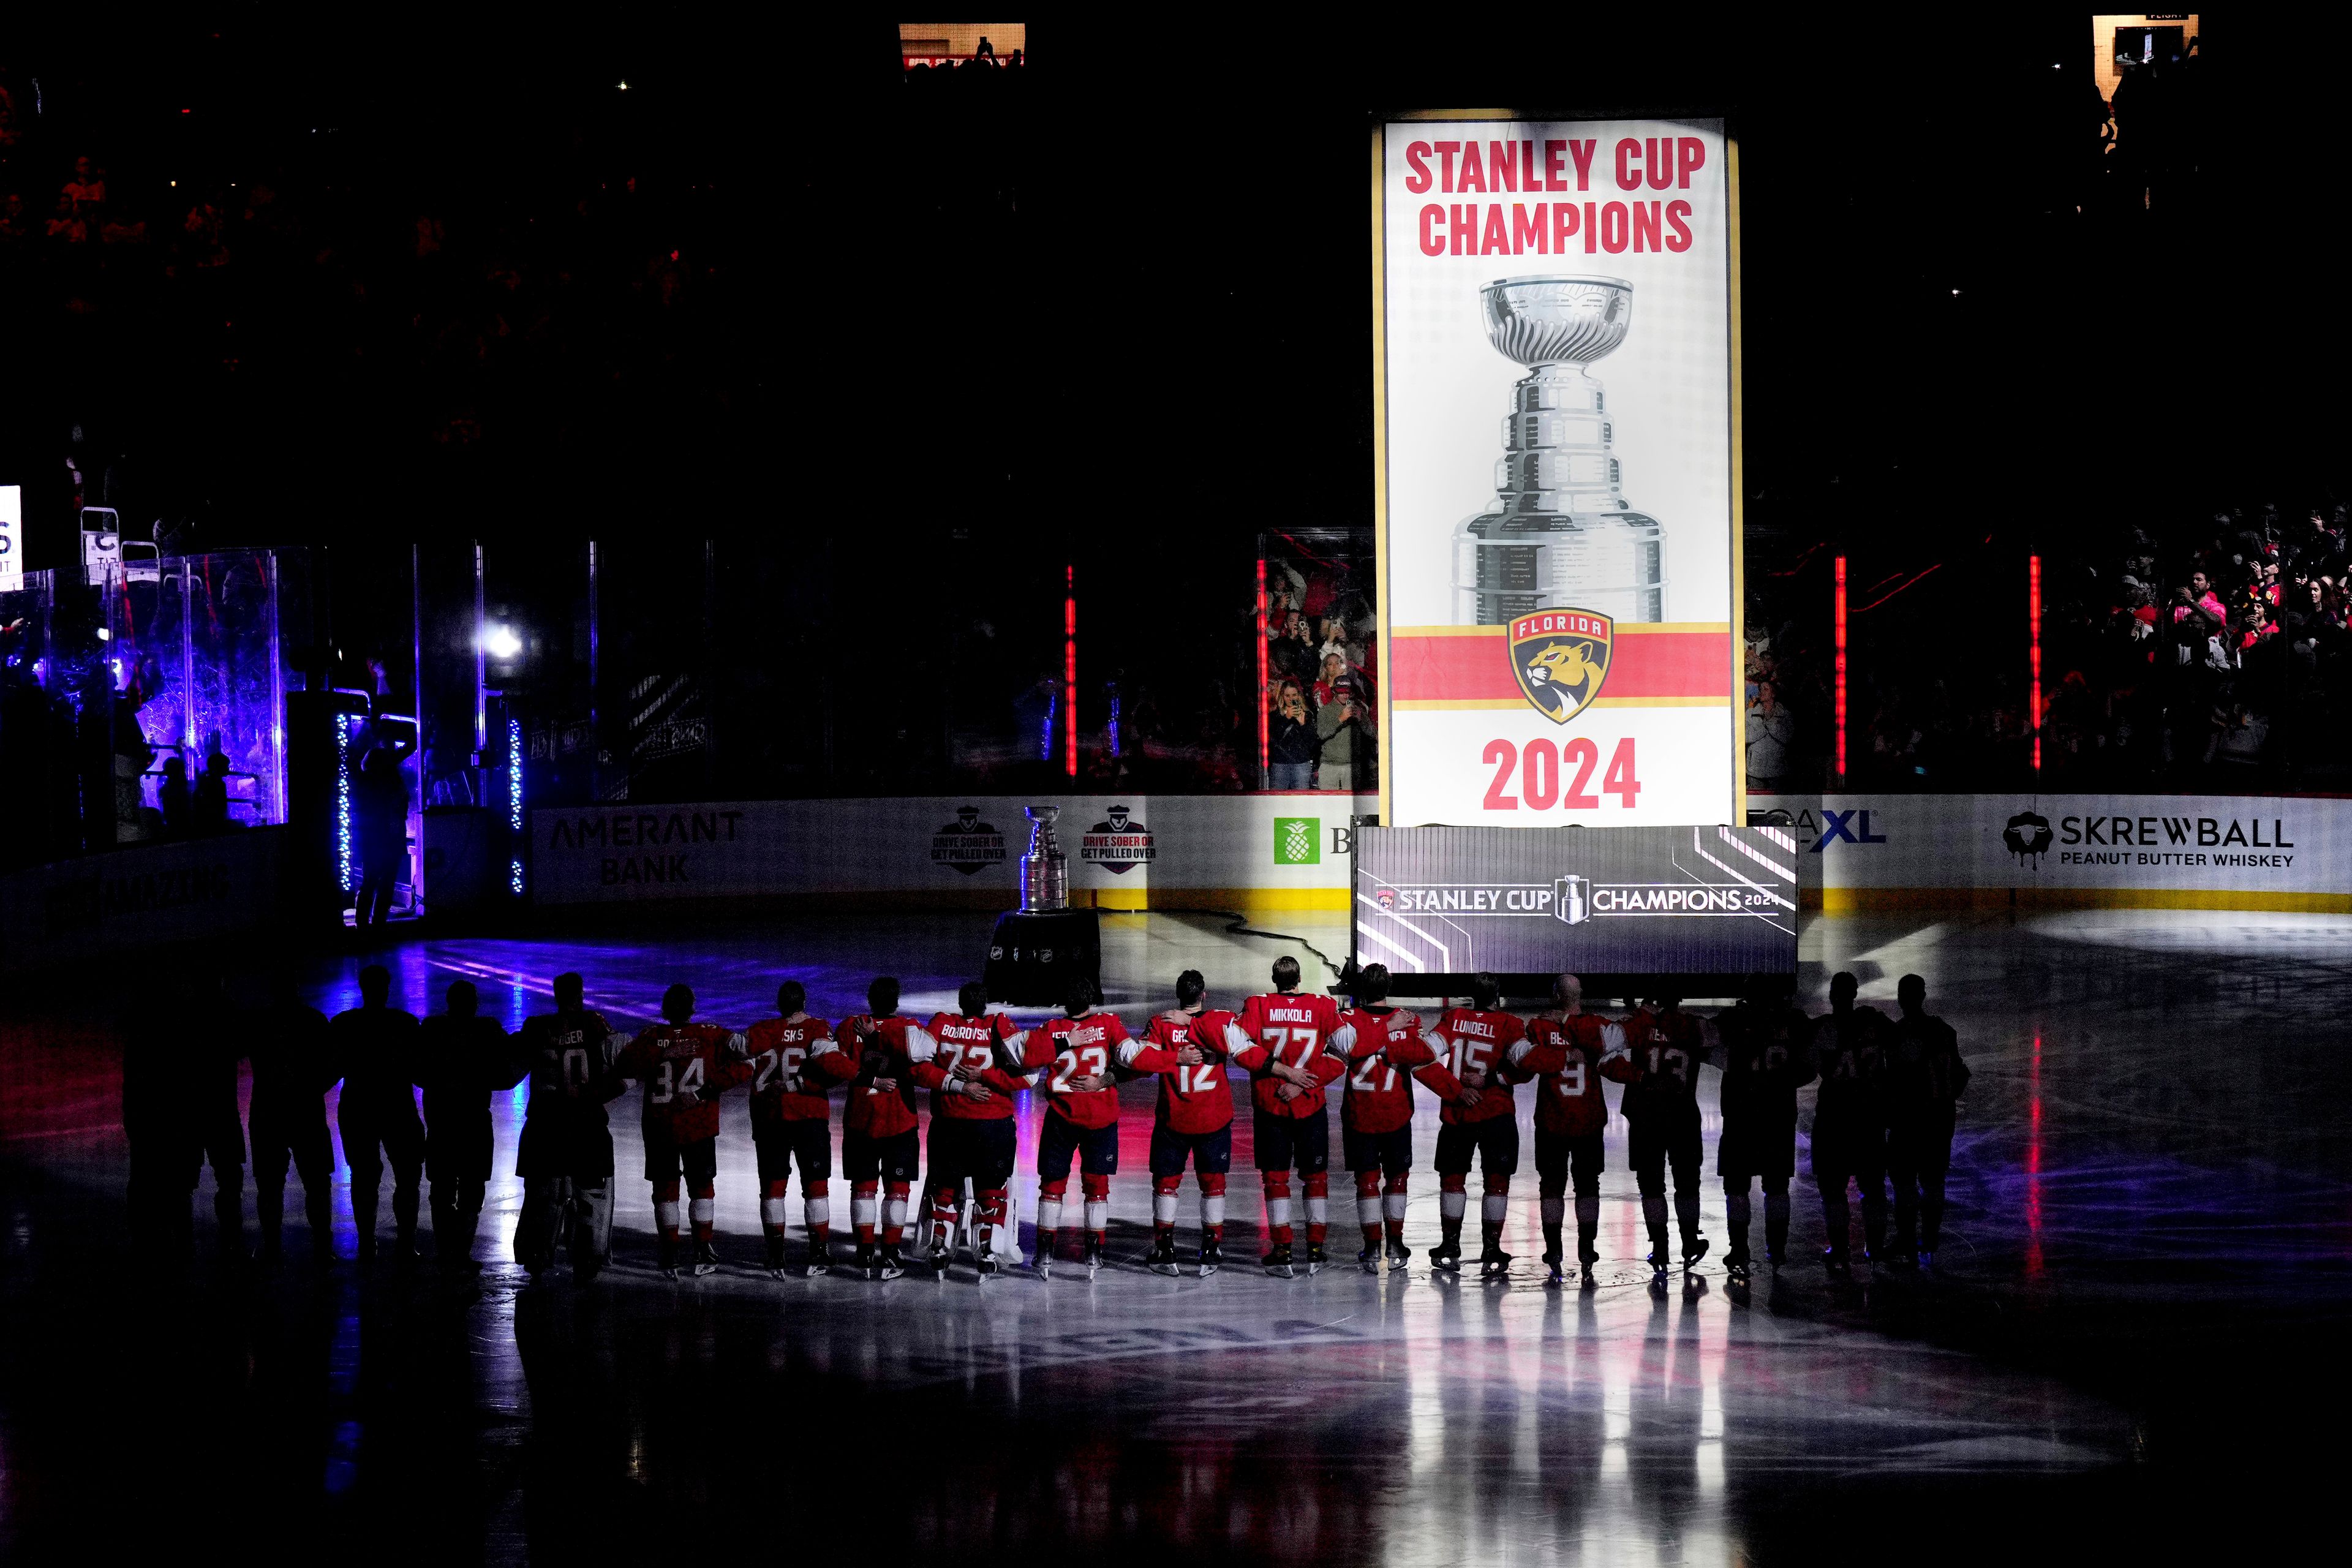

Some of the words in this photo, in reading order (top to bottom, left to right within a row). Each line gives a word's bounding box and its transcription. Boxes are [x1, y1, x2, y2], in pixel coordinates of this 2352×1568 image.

[1405, 139, 1597, 194] STANLEY
[1615, 137, 1705, 191] CUP
[1419, 200, 1692, 256] CHAMPIONS
[1519, 615, 1602, 638] FLORIDA
[1482, 737, 1642, 811] 2024
[549, 811, 742, 850] AMERANT
[932, 836, 959, 848] DRIVE
[960, 836, 990, 848] SOBER
[990, 836, 1004, 848] OR
[1083, 836, 1109, 847] DRIVE
[1110, 835, 1140, 847] SOBER
[1141, 836, 1154, 847] OR
[2060, 816, 2294, 848] SKREWBALL
[949, 848, 982, 860] PULLED
[982, 848, 1006, 860] OVER
[1081, 848, 1098, 859] GET
[1099, 848, 1132, 859] PULLED
[1133, 848, 1156, 859] OVER
[2061, 852, 2132, 865] PEANUT
[2138, 853, 2207, 866] BUTTER
[2213, 854, 2294, 868] WHISKEY
[601, 854, 690, 886] BANK
[1399, 890, 1501, 910] STANLEY
[1506, 890, 1551, 910] CUP
[1593, 889, 1741, 911] CHAMPIONS
[1744, 894, 1779, 906] 2024
[1269, 1009, 1312, 1023] MIKKOLA
[1452, 1018, 1496, 1038] LUNDELL
[1261, 1027, 1318, 1069] 77
[1450, 1038, 1495, 1079] 15
[651, 1058, 704, 1104] 34
[1052, 1046, 1107, 1093] 23
